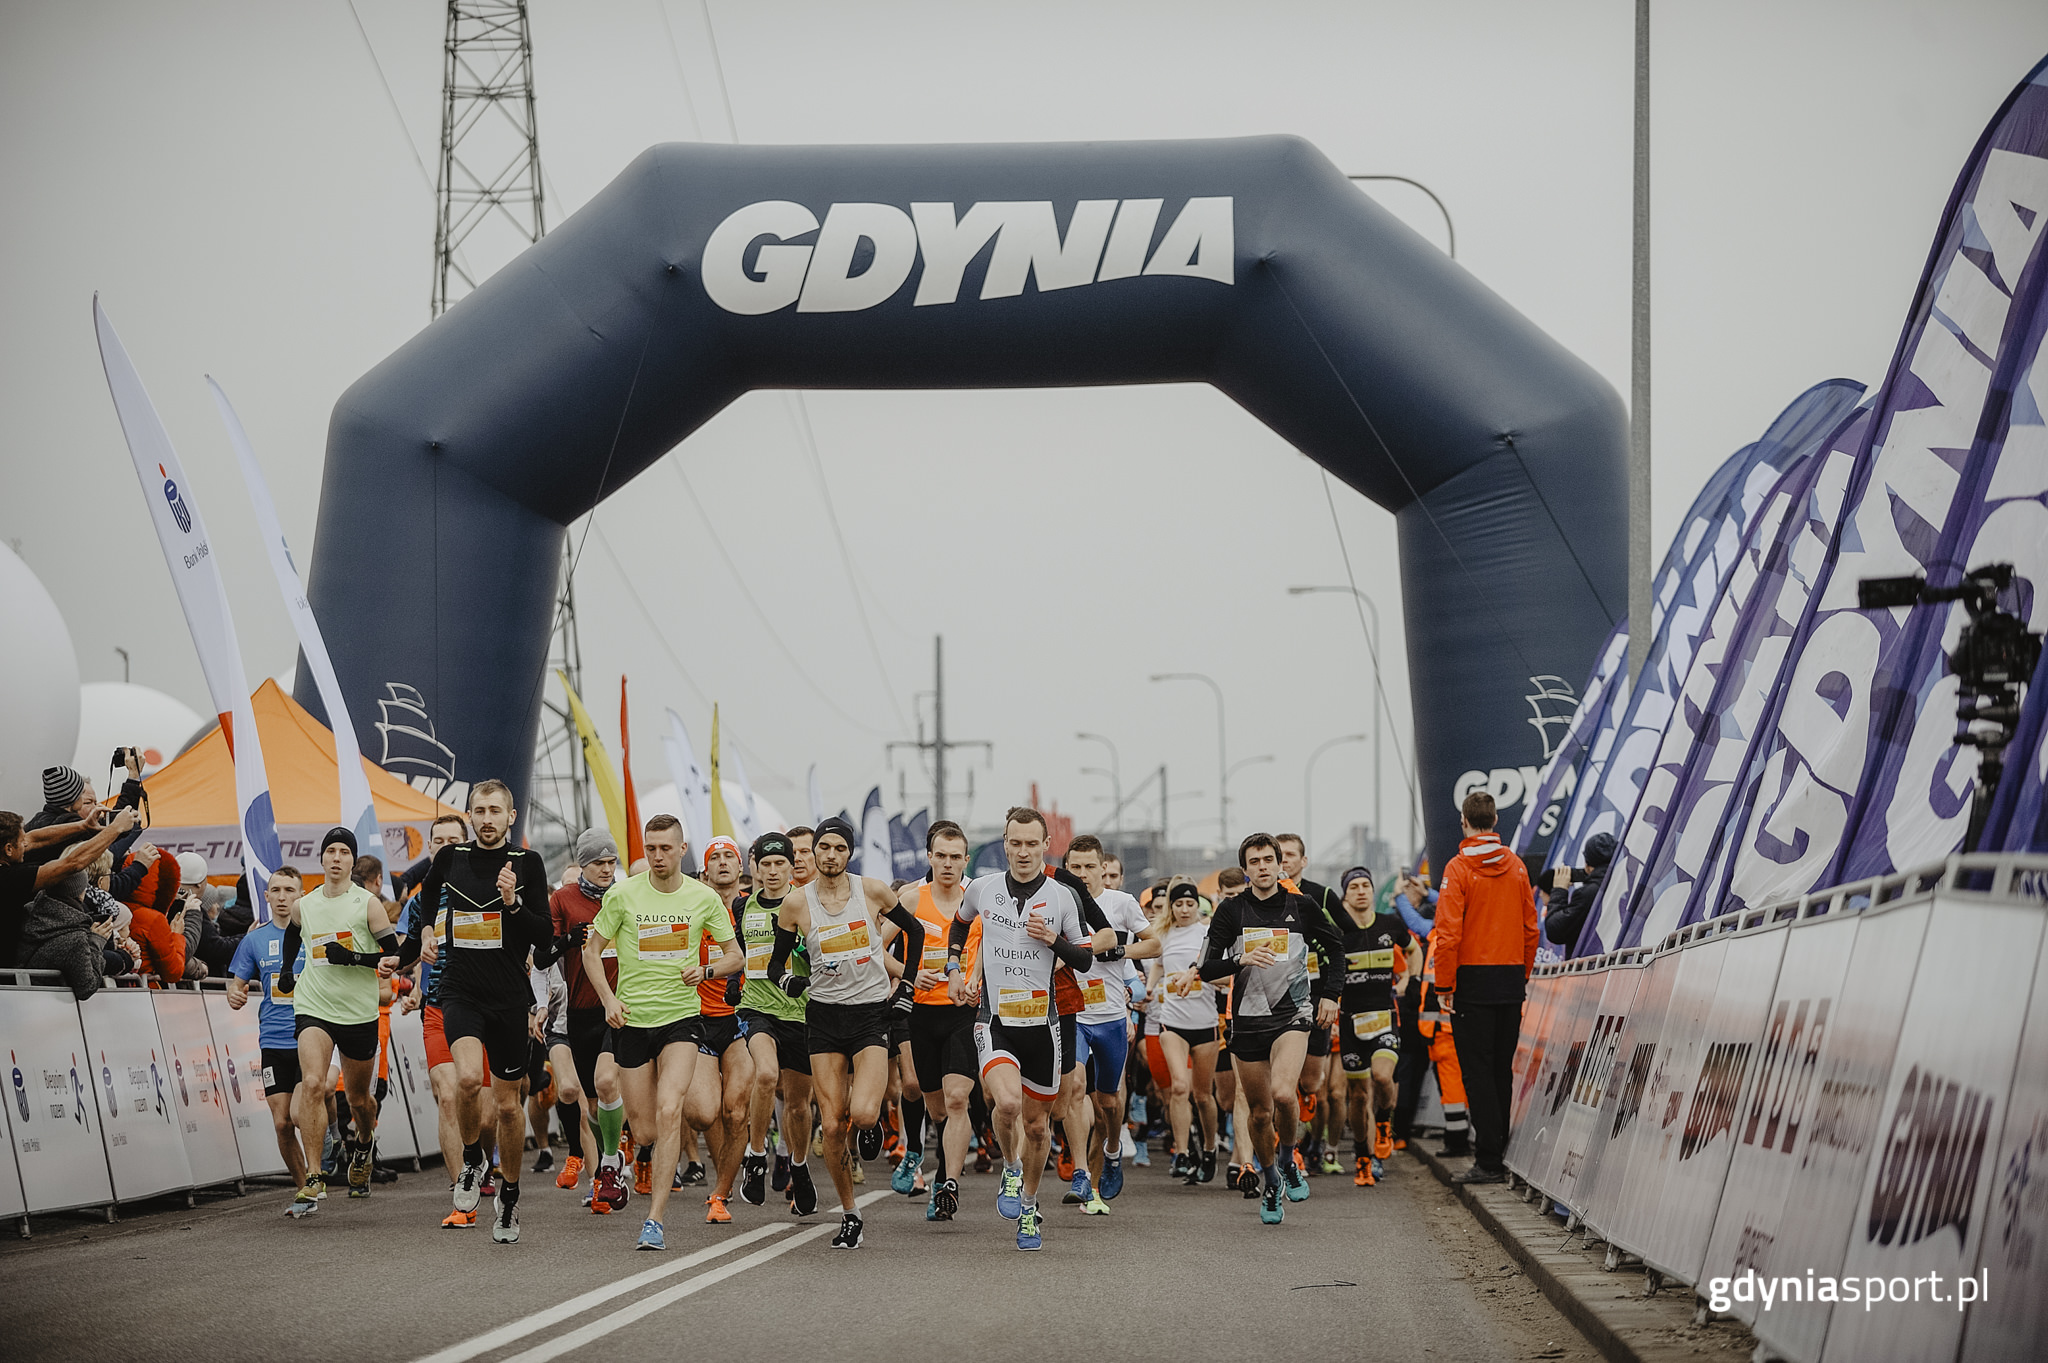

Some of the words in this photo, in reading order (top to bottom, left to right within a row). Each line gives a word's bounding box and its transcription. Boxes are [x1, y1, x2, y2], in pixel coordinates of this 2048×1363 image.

[701, 196, 1235, 316] GDYNIA
[635, 914, 692, 923] SAUCONY
[491, 926, 499, 937] 2
[679, 937, 687, 947] 3
[851, 934, 868, 947] 16
[994, 946, 1040, 960] KUBIAK
[1004, 966, 1030, 978] POL
[1016, 1003, 1046, 1015] 1078
[1679, 1040, 1753, 1163] GDYNIA
[1867, 1060, 1996, 1258] GDYNIA
